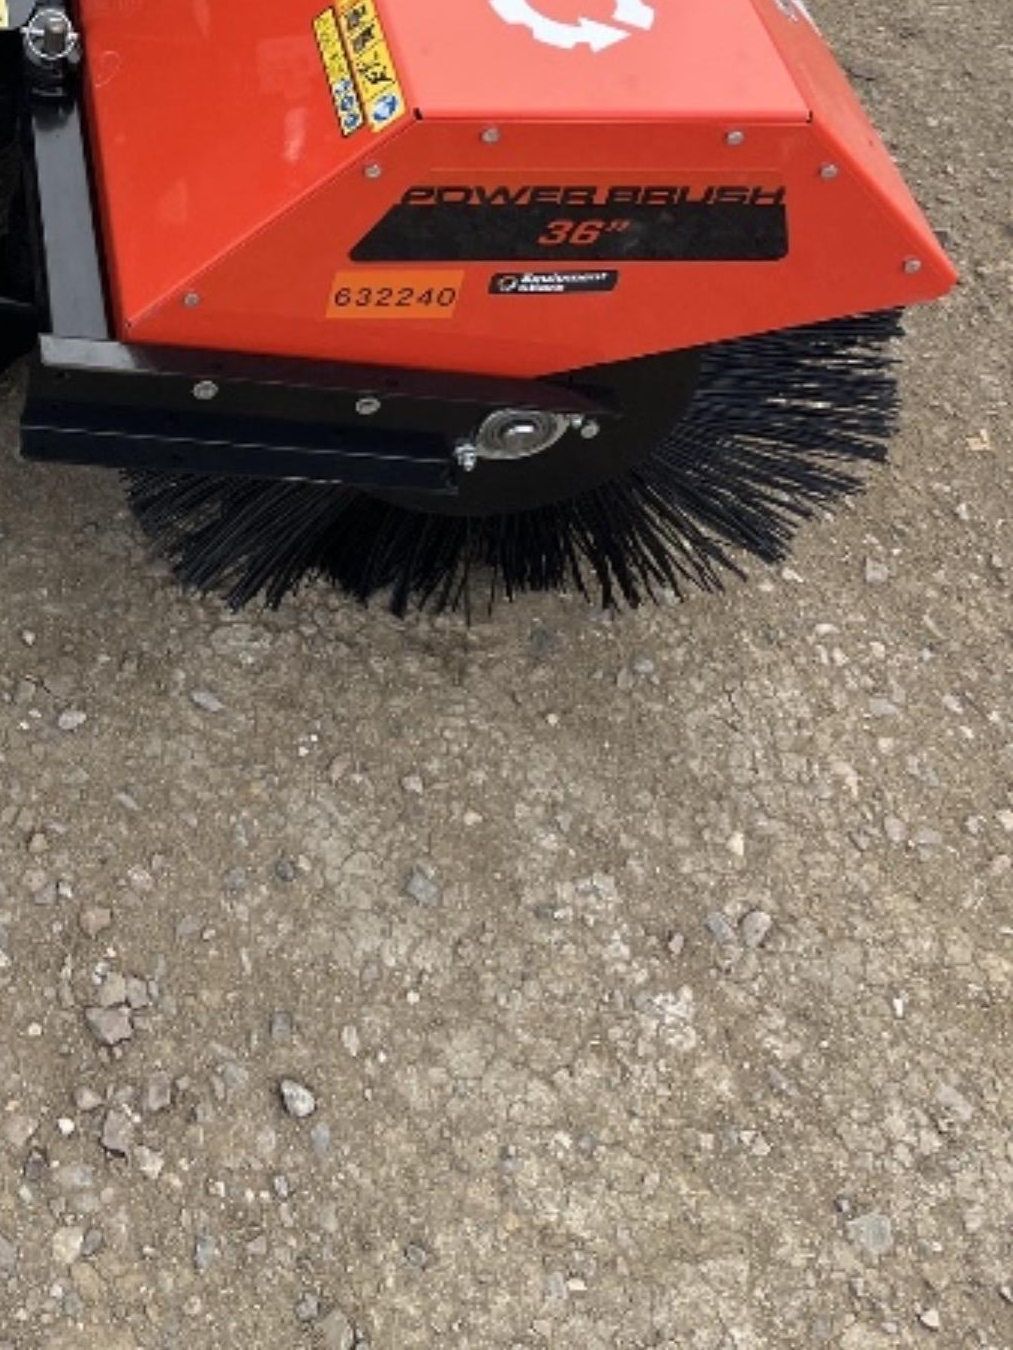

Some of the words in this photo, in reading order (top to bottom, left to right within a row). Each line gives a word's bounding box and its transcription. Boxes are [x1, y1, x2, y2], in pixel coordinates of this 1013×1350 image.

[399, 185, 597, 206] POWER
[600, 185, 787, 206] BRUSH
[333, 286, 457, 307] 632240
